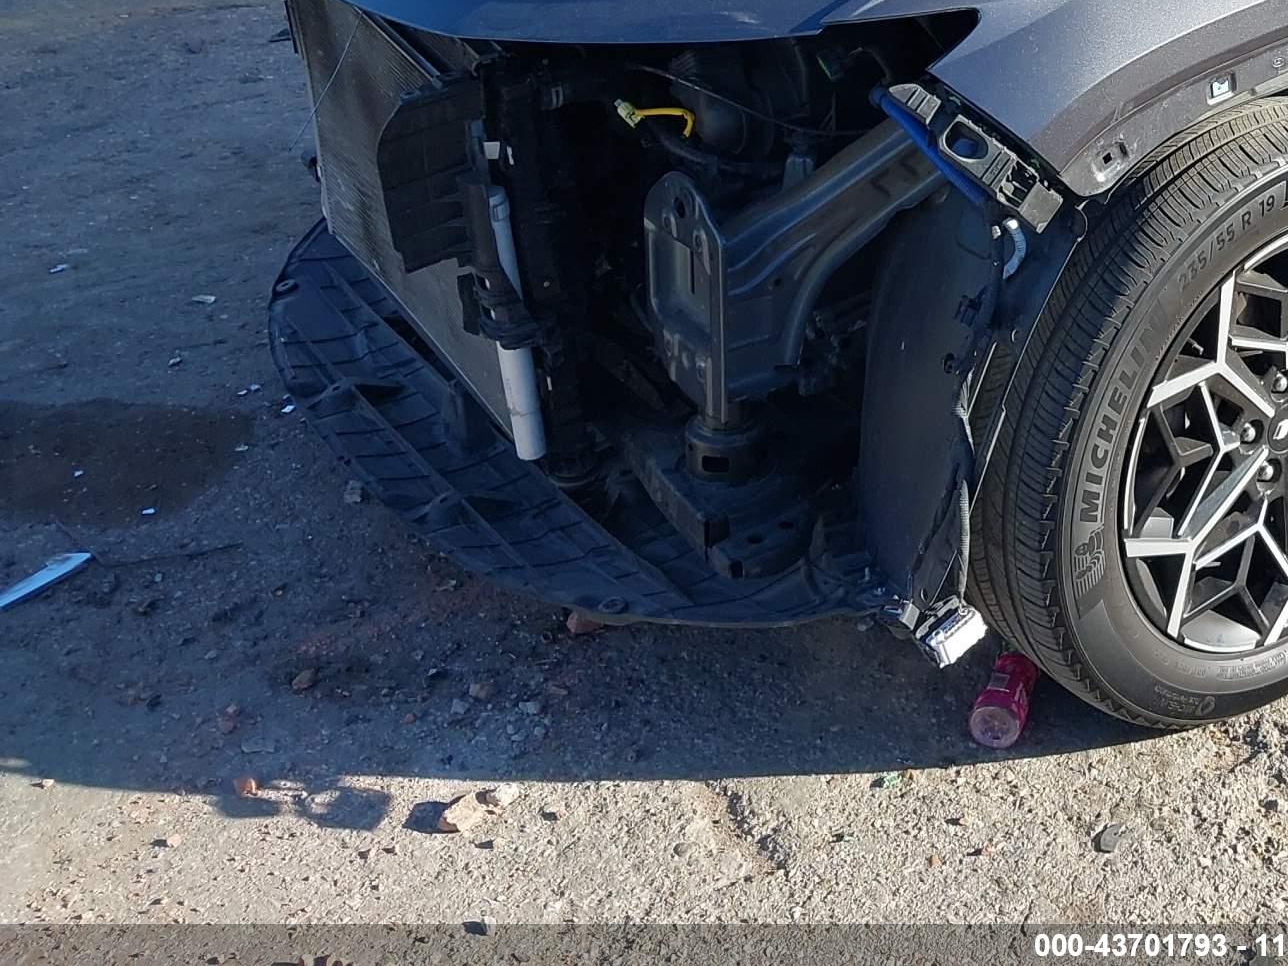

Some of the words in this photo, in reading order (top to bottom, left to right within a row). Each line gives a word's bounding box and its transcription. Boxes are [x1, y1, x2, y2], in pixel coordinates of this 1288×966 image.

[1177, 222, 1236, 292] 235/55
[1241, 211, 1252, 231] R
[1258, 194, 1276, 218] 19
[1080, 297, 1172, 523] MICHELIN
